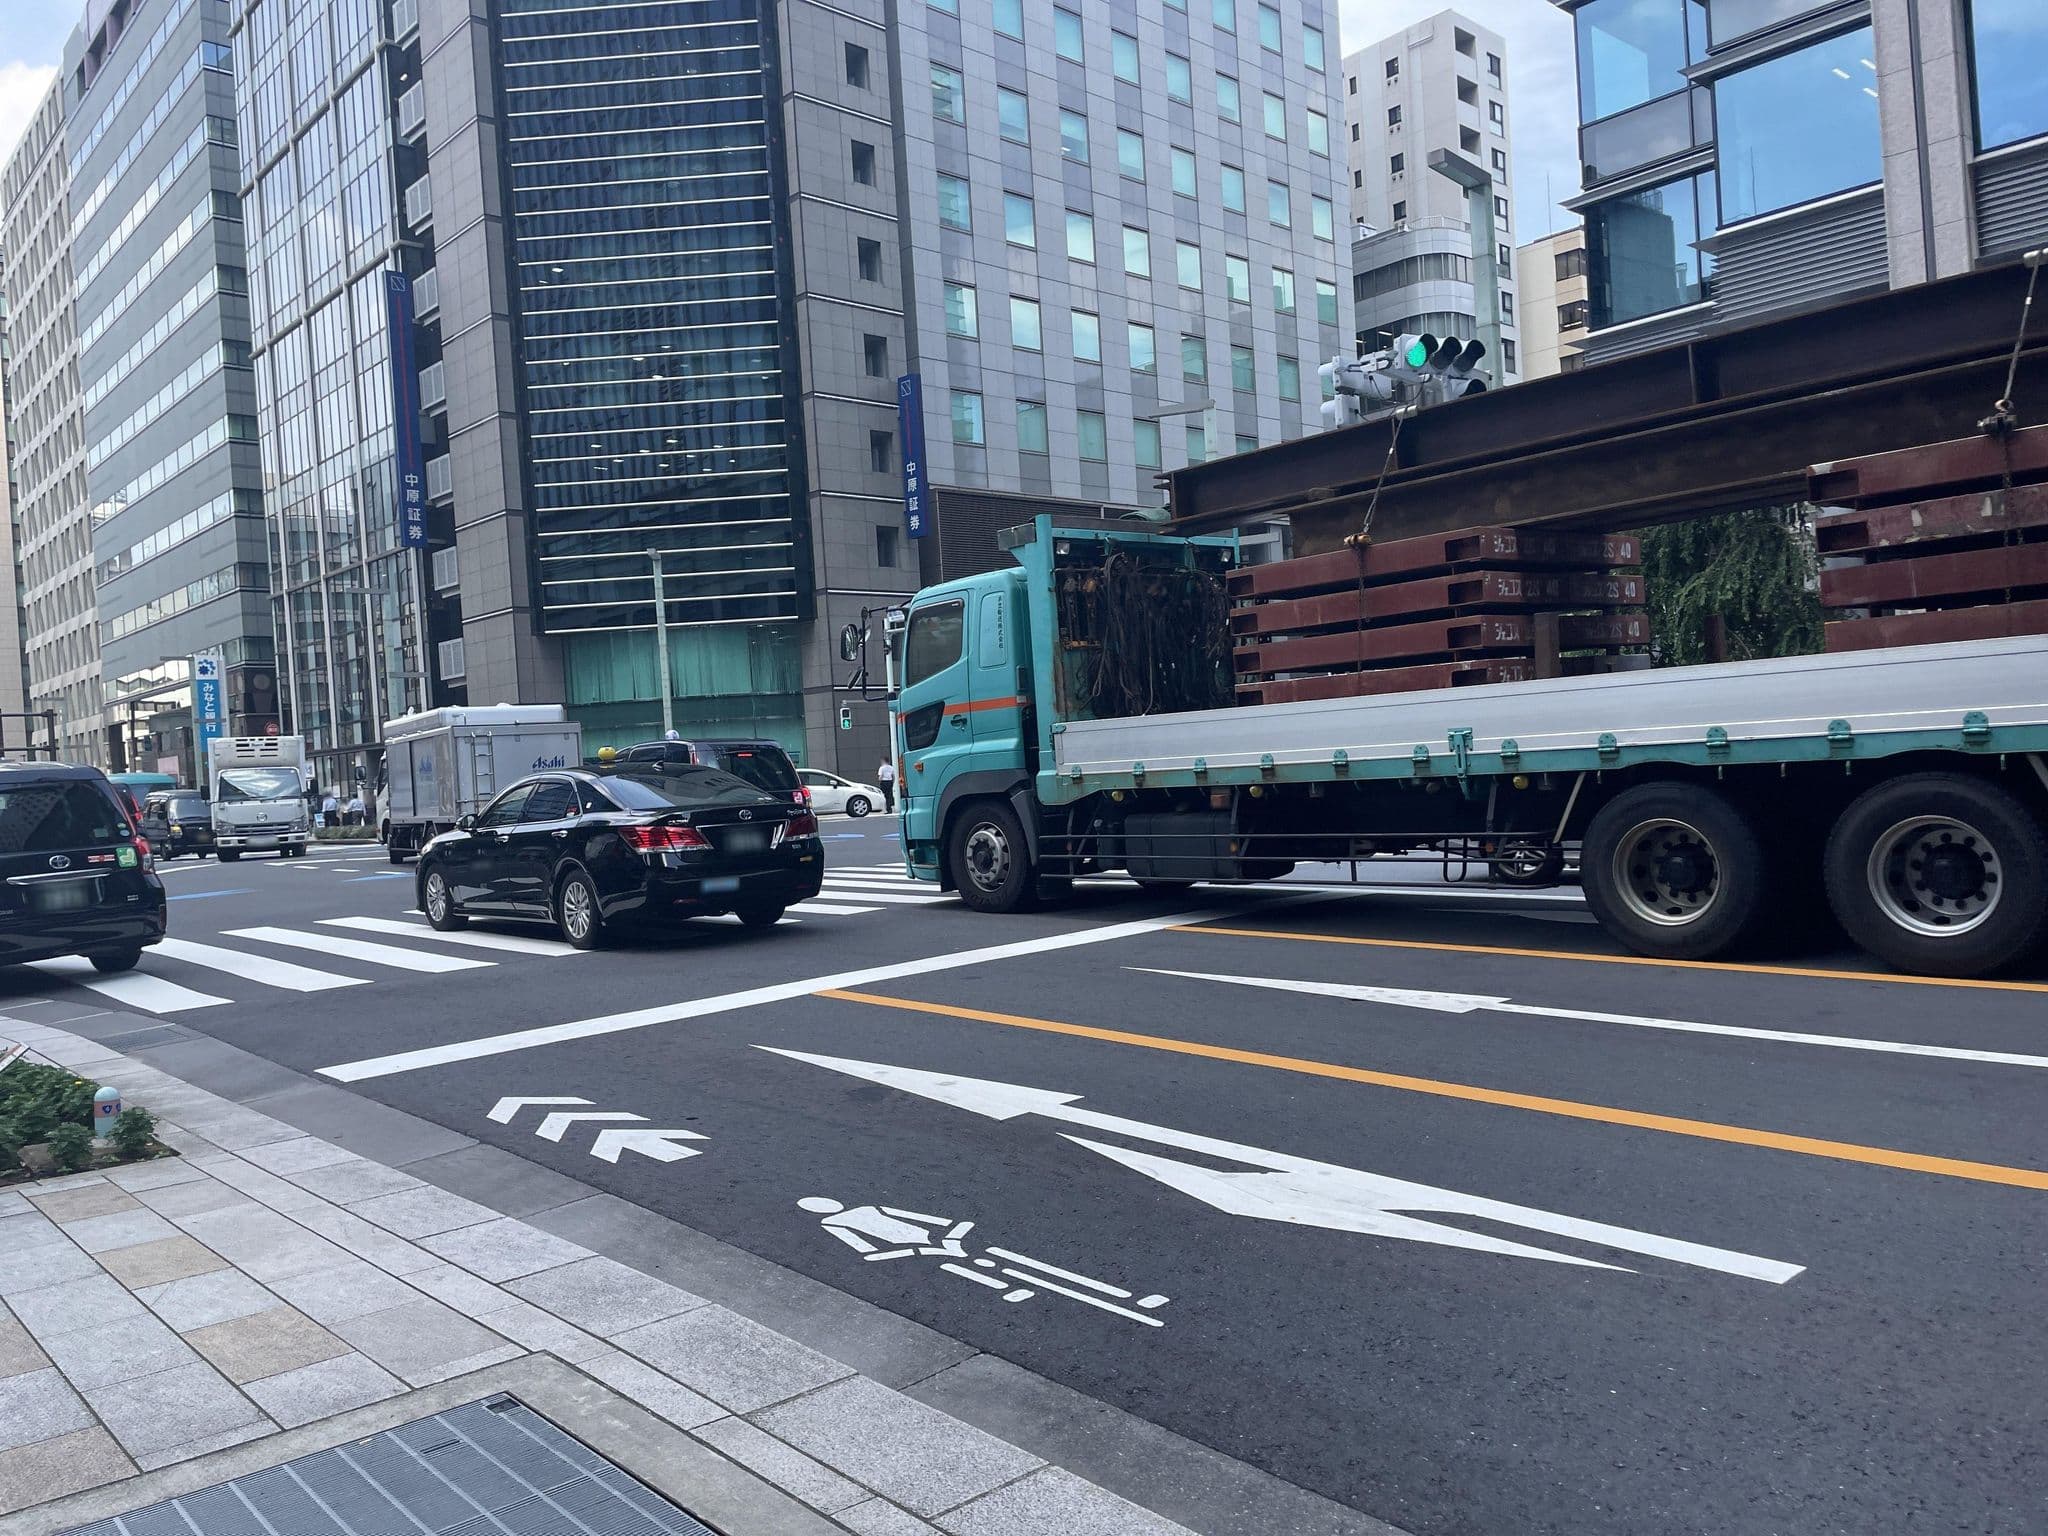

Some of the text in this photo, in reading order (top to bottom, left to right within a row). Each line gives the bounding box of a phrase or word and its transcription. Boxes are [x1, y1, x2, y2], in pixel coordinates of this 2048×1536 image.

[404, 472, 423, 540] 中原証券
[906, 460, 920, 530] 中原証券
[202, 682, 216, 731] みなと銀行
[532, 754, 565, 769] Asahi
